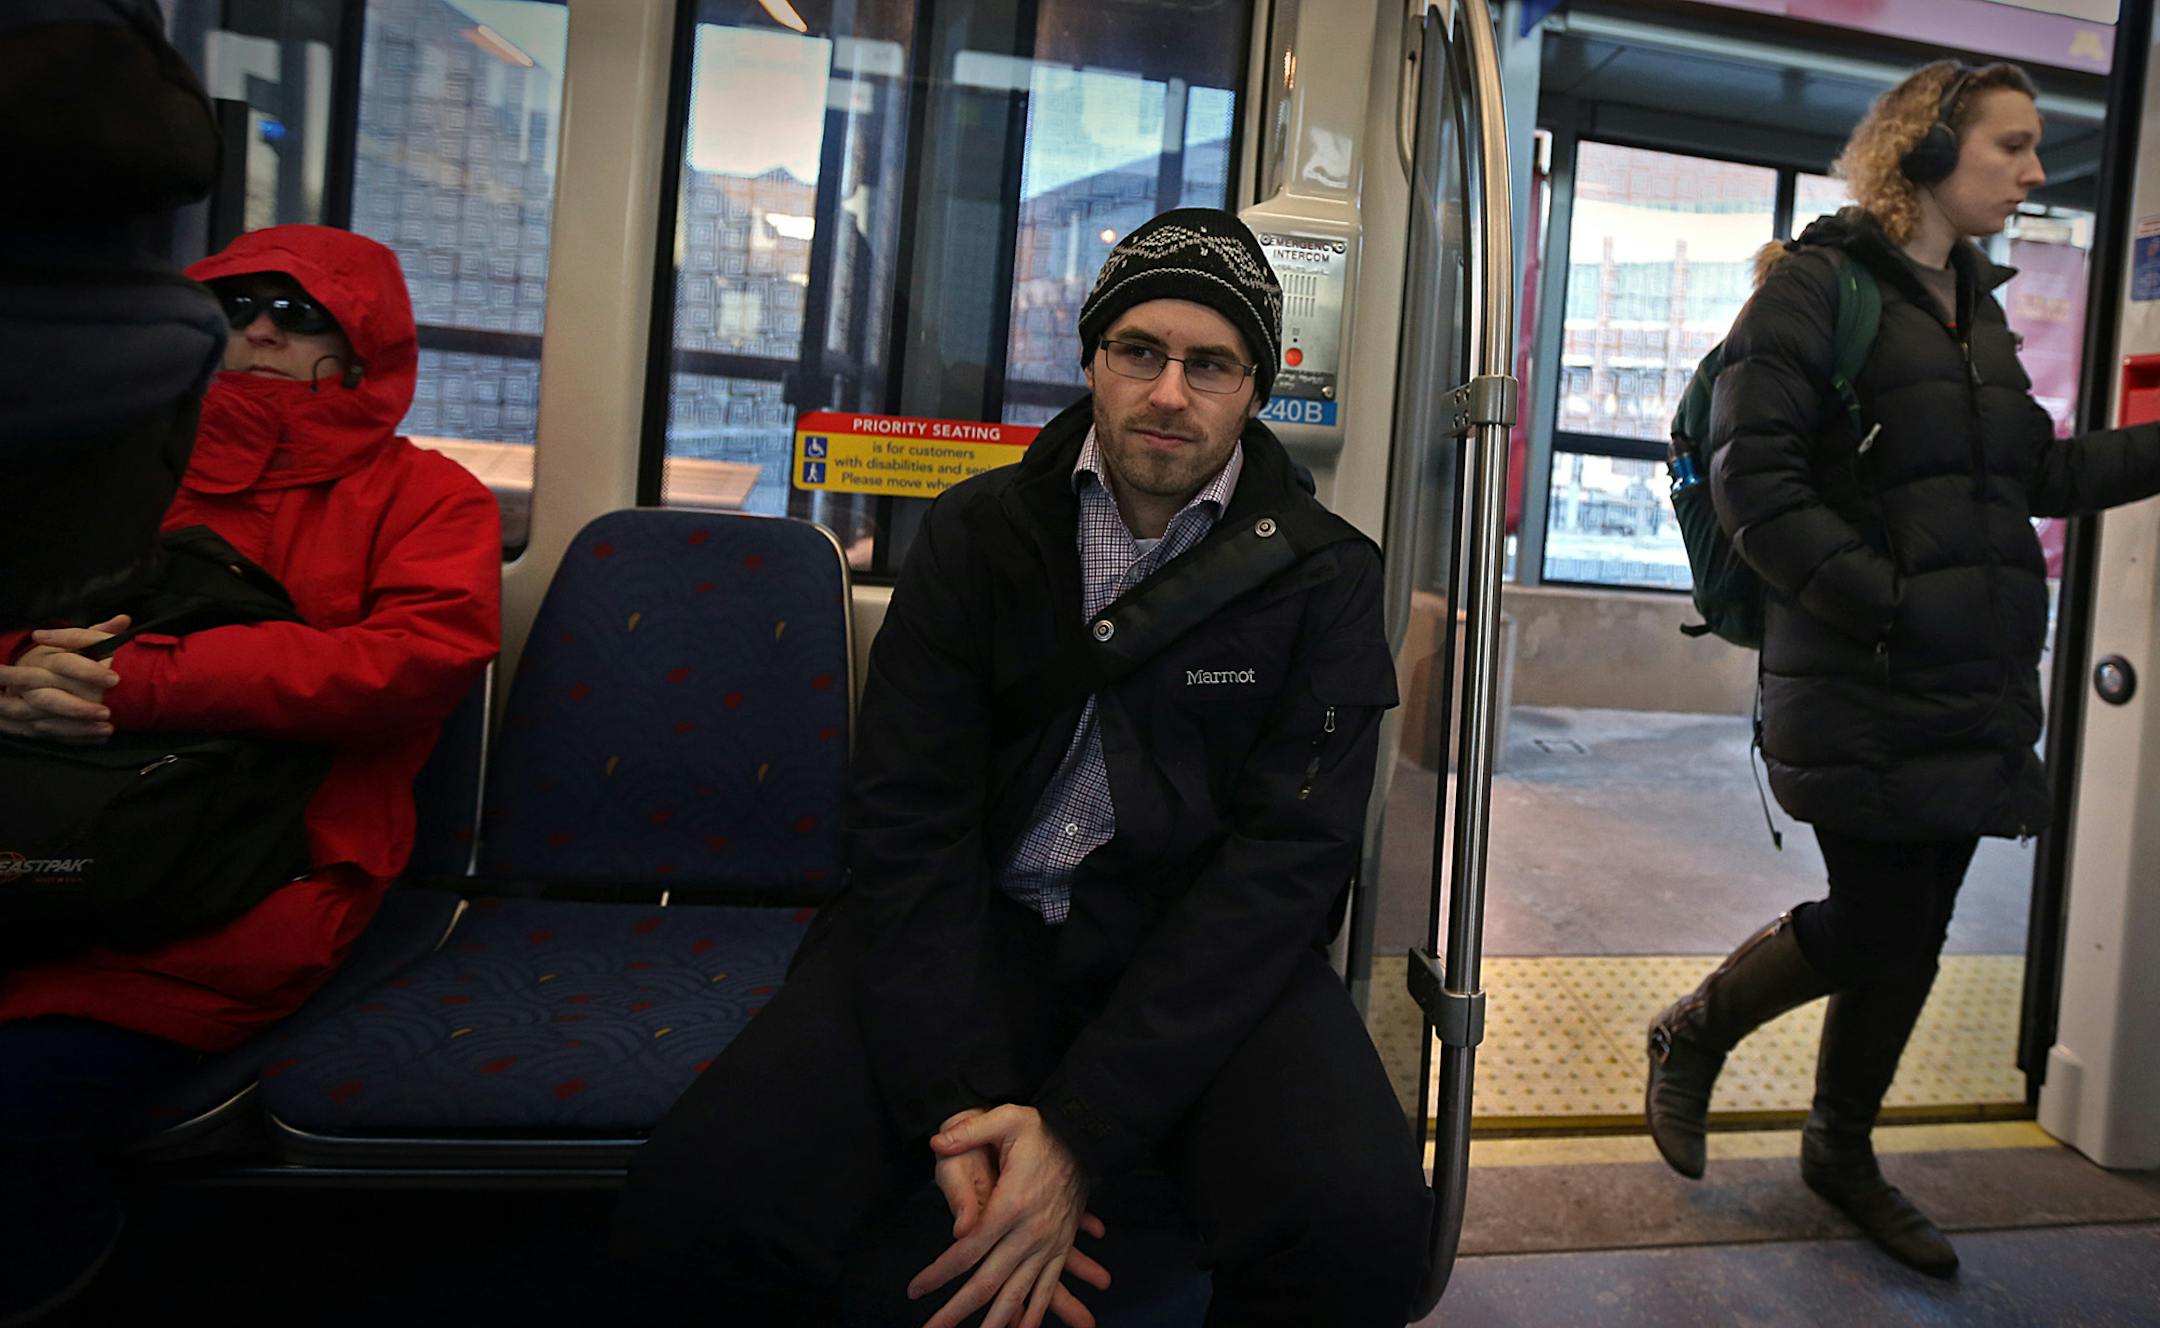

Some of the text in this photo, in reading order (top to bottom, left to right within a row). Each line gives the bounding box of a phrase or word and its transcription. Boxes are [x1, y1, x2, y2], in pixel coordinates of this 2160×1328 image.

[1273, 249, 1330, 263] INTERCOM
[1256, 399, 1323, 423] 240B
[852, 417, 1001, 441] PRIORITY SEATING
[872, 441, 975, 460] is for customers
[834, 457, 863, 469] with
[866, 458, 933, 474] disabilities
[937, 463, 962, 475] and
[841, 472, 883, 486] Please
[886, 477, 922, 489] move
[1186, 668, 1256, 685] Marmot
